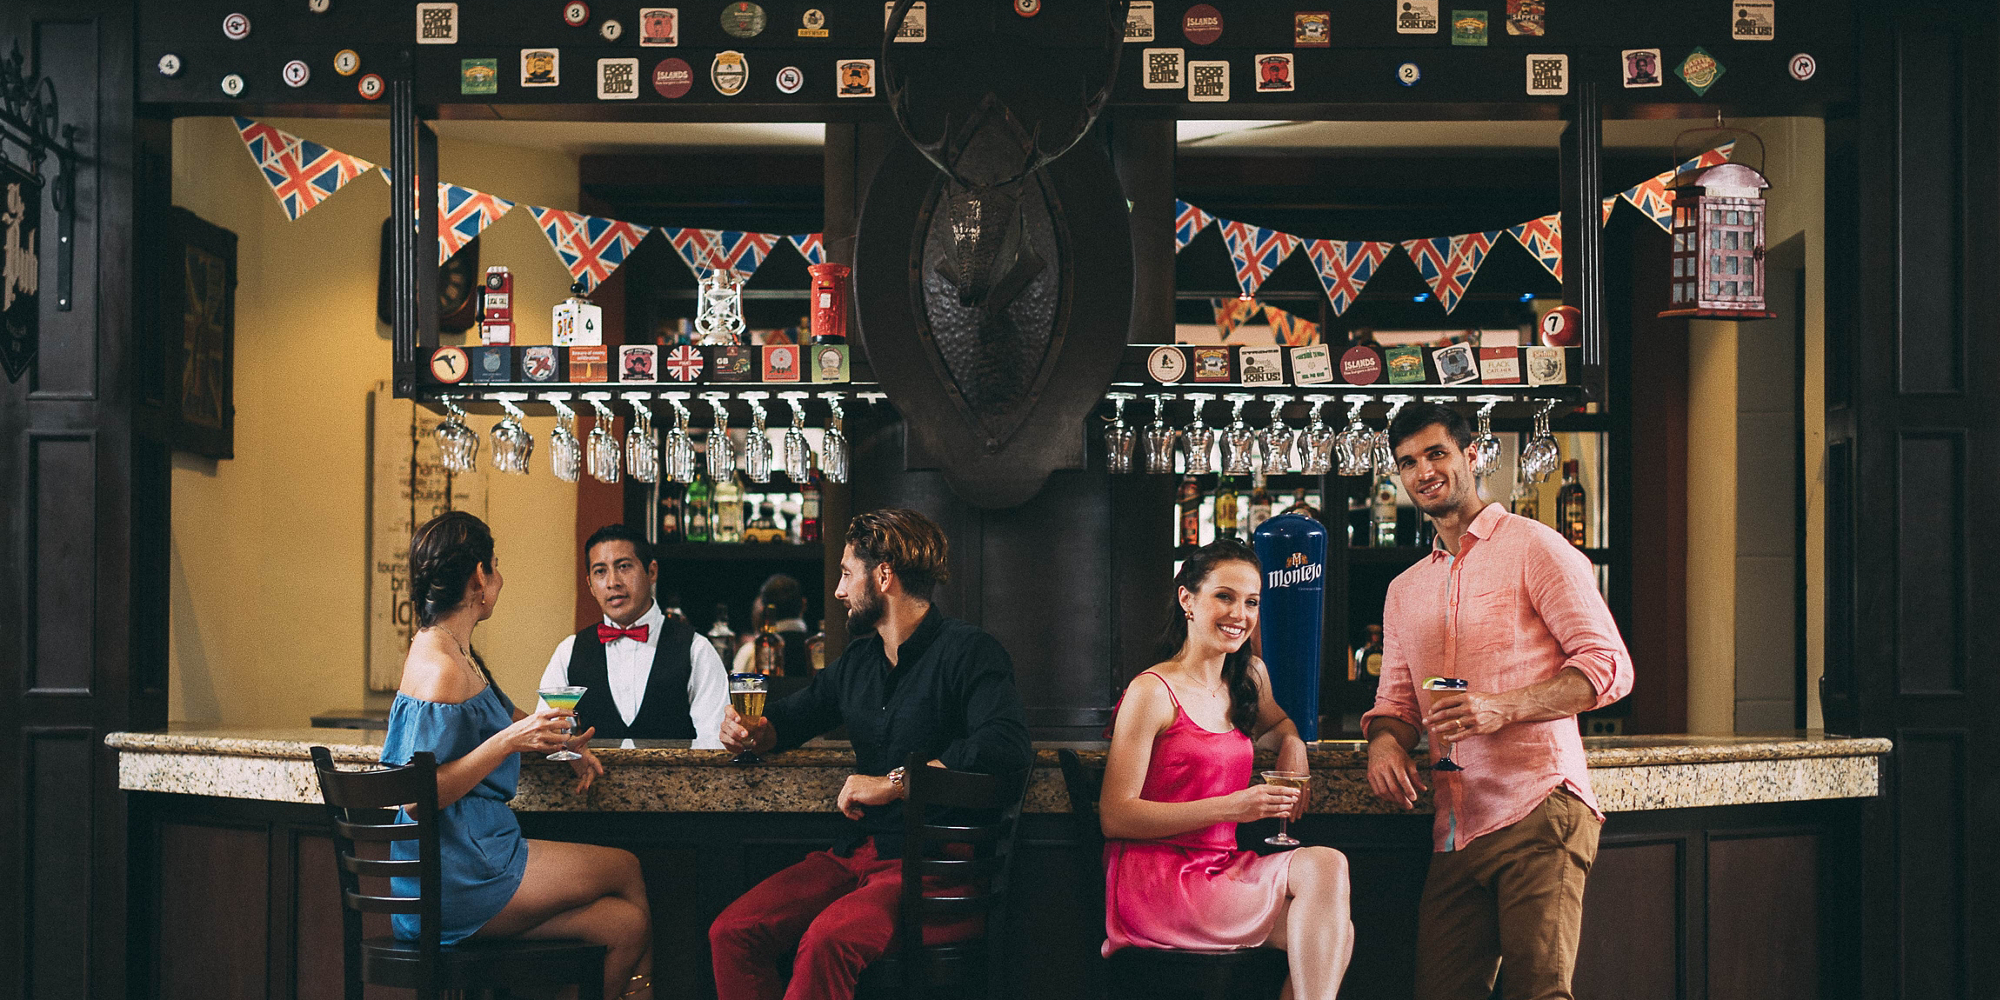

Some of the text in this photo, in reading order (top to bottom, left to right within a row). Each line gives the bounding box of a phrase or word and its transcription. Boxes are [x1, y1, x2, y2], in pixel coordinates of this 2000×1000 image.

[571, 8, 580, 18] 3
[1187, 17, 1218, 26] ISLANDS
[1399, 20, 1436, 28] JOIN US!
[606, 25, 615, 35] 7
[1735, 27, 1772, 35] JOIN US!
[343, 57, 349, 67] 1
[1149, 54, 1179, 64] FOOD
[165, 60, 174, 69] 4
[1532, 60, 1562, 70] FOOD
[657, 71, 688, 80] ISLANDS
[1149, 70, 1179, 83] BUILT
[1194, 66, 1223, 77] FOOD
[1405, 68, 1413, 78] 2
[228, 79, 237, 89] 6
[366, 81, 375, 91] 5
[1532, 76, 1562, 89] BUILT
[1194, 82, 1223, 96] BUILT
[1548, 316, 1559, 331] 7
[716, 357, 729, 365] GB
[1344, 358, 1376, 371] ISLANDS
[1243, 372, 1280, 382] JOIN US!
[1268, 562, 1322, 589] Montejo
